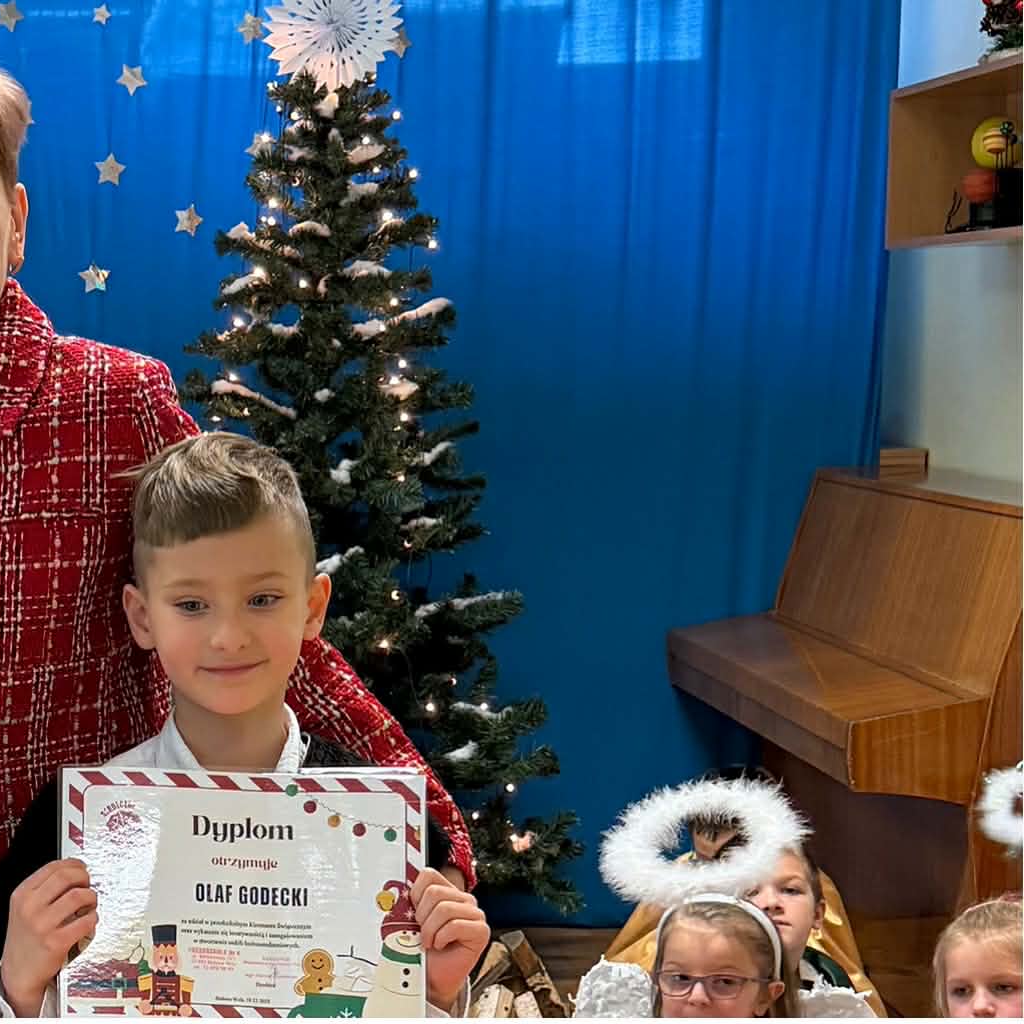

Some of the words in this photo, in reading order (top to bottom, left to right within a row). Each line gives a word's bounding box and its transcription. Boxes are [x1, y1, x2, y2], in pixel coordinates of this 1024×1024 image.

[191, 815, 294, 843] Dyplom
[211, 856, 278, 871] otrzymuje
[195, 883, 233, 903] OLAF
[239, 885, 308, 907] GODECKI
